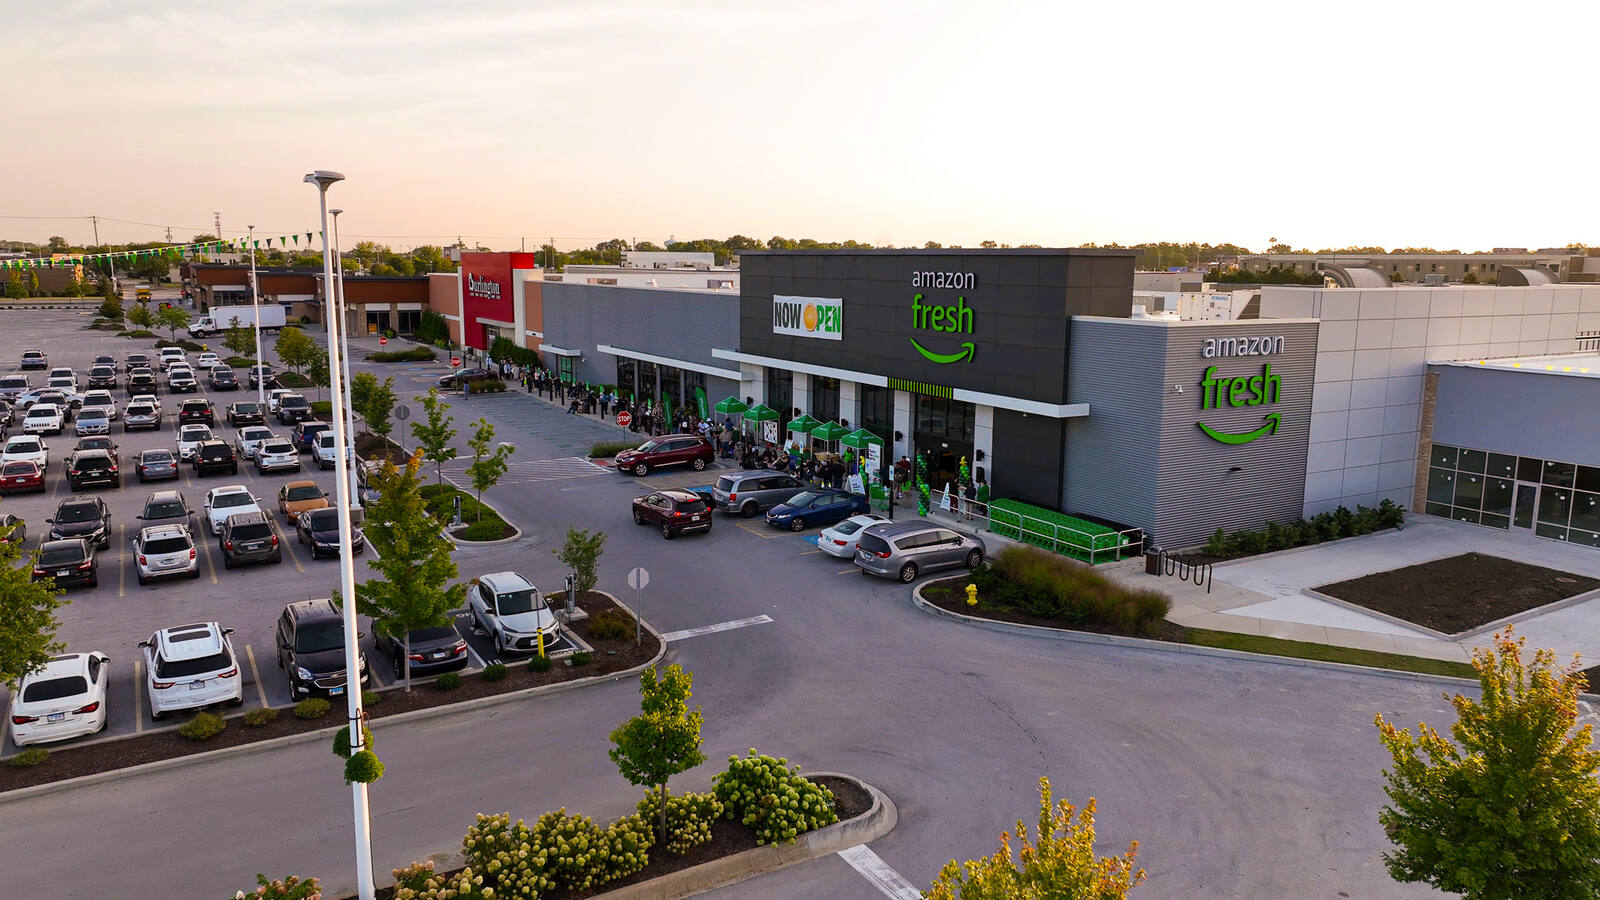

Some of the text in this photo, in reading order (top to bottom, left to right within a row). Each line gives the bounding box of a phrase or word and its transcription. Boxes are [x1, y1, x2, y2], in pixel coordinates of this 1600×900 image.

[912, 271, 975, 289] amazon
[774, 302, 801, 329] NOW
[912, 294, 973, 334] fresh
[1203, 336, 1285, 358] amazon
[1201, 363, 1282, 410] fresh
[618, 415, 631, 423] STOP
